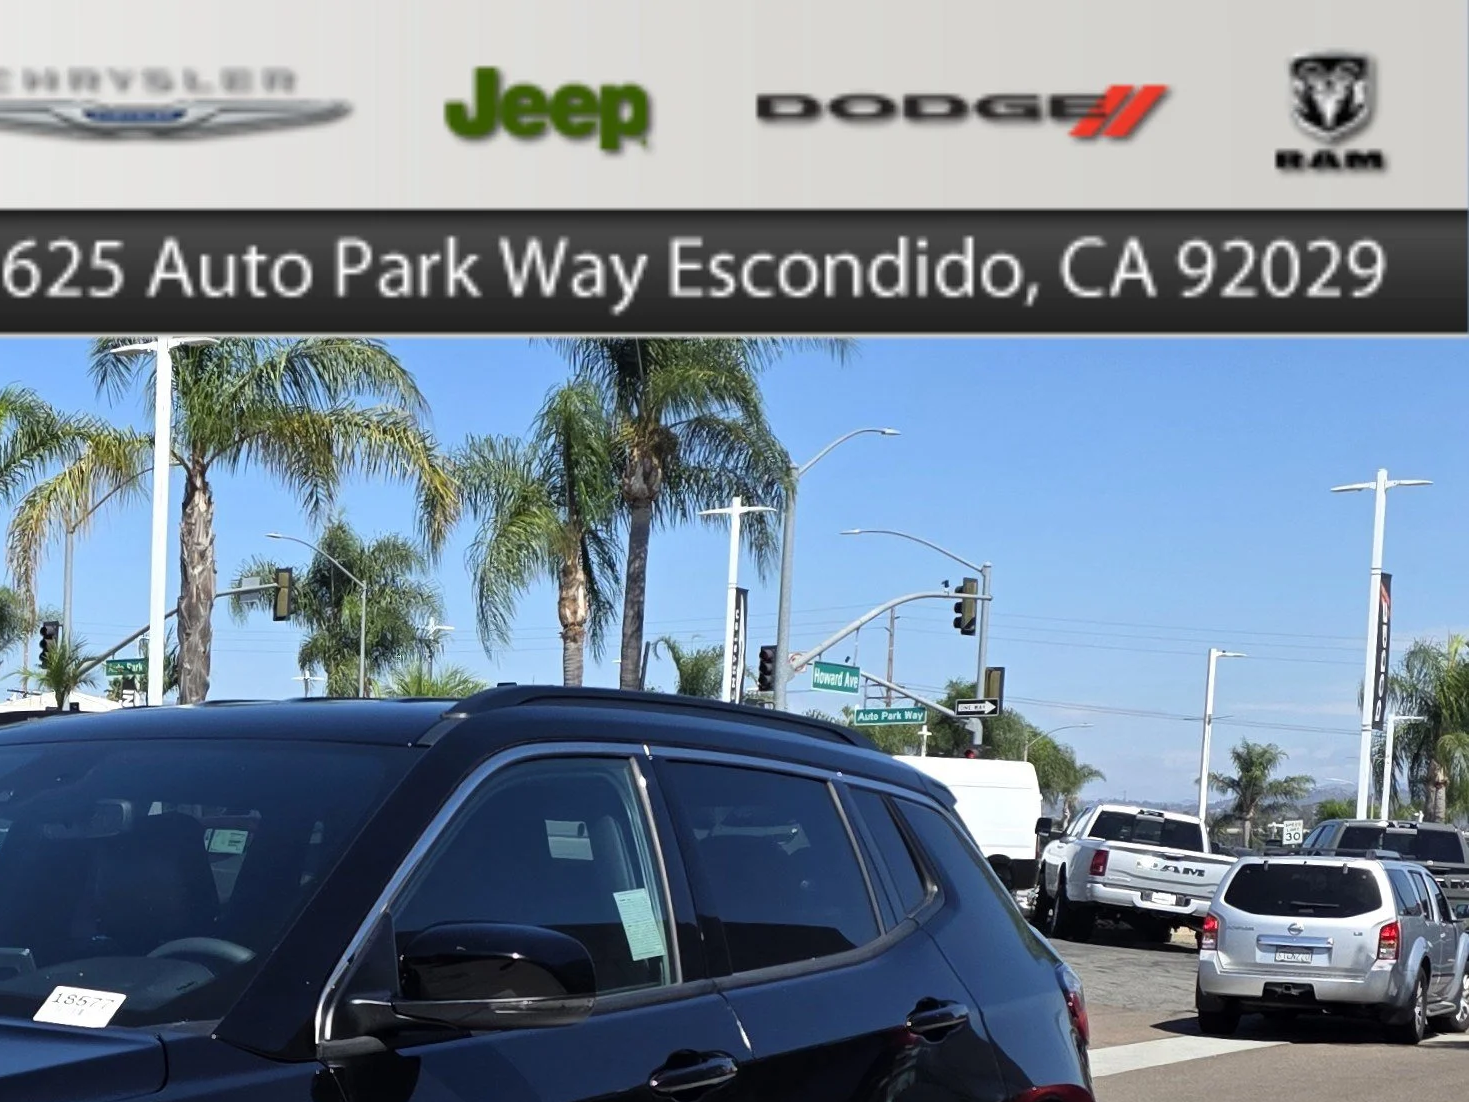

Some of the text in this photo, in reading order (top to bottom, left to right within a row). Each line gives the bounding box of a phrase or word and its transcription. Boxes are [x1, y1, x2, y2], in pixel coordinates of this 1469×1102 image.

[813, 667, 858, 689] Howard Ave
[857, 710, 924, 721] Auto Park Way
[1285, 832, 1301, 842] 30
[52, 992, 116, 1010] 18577
